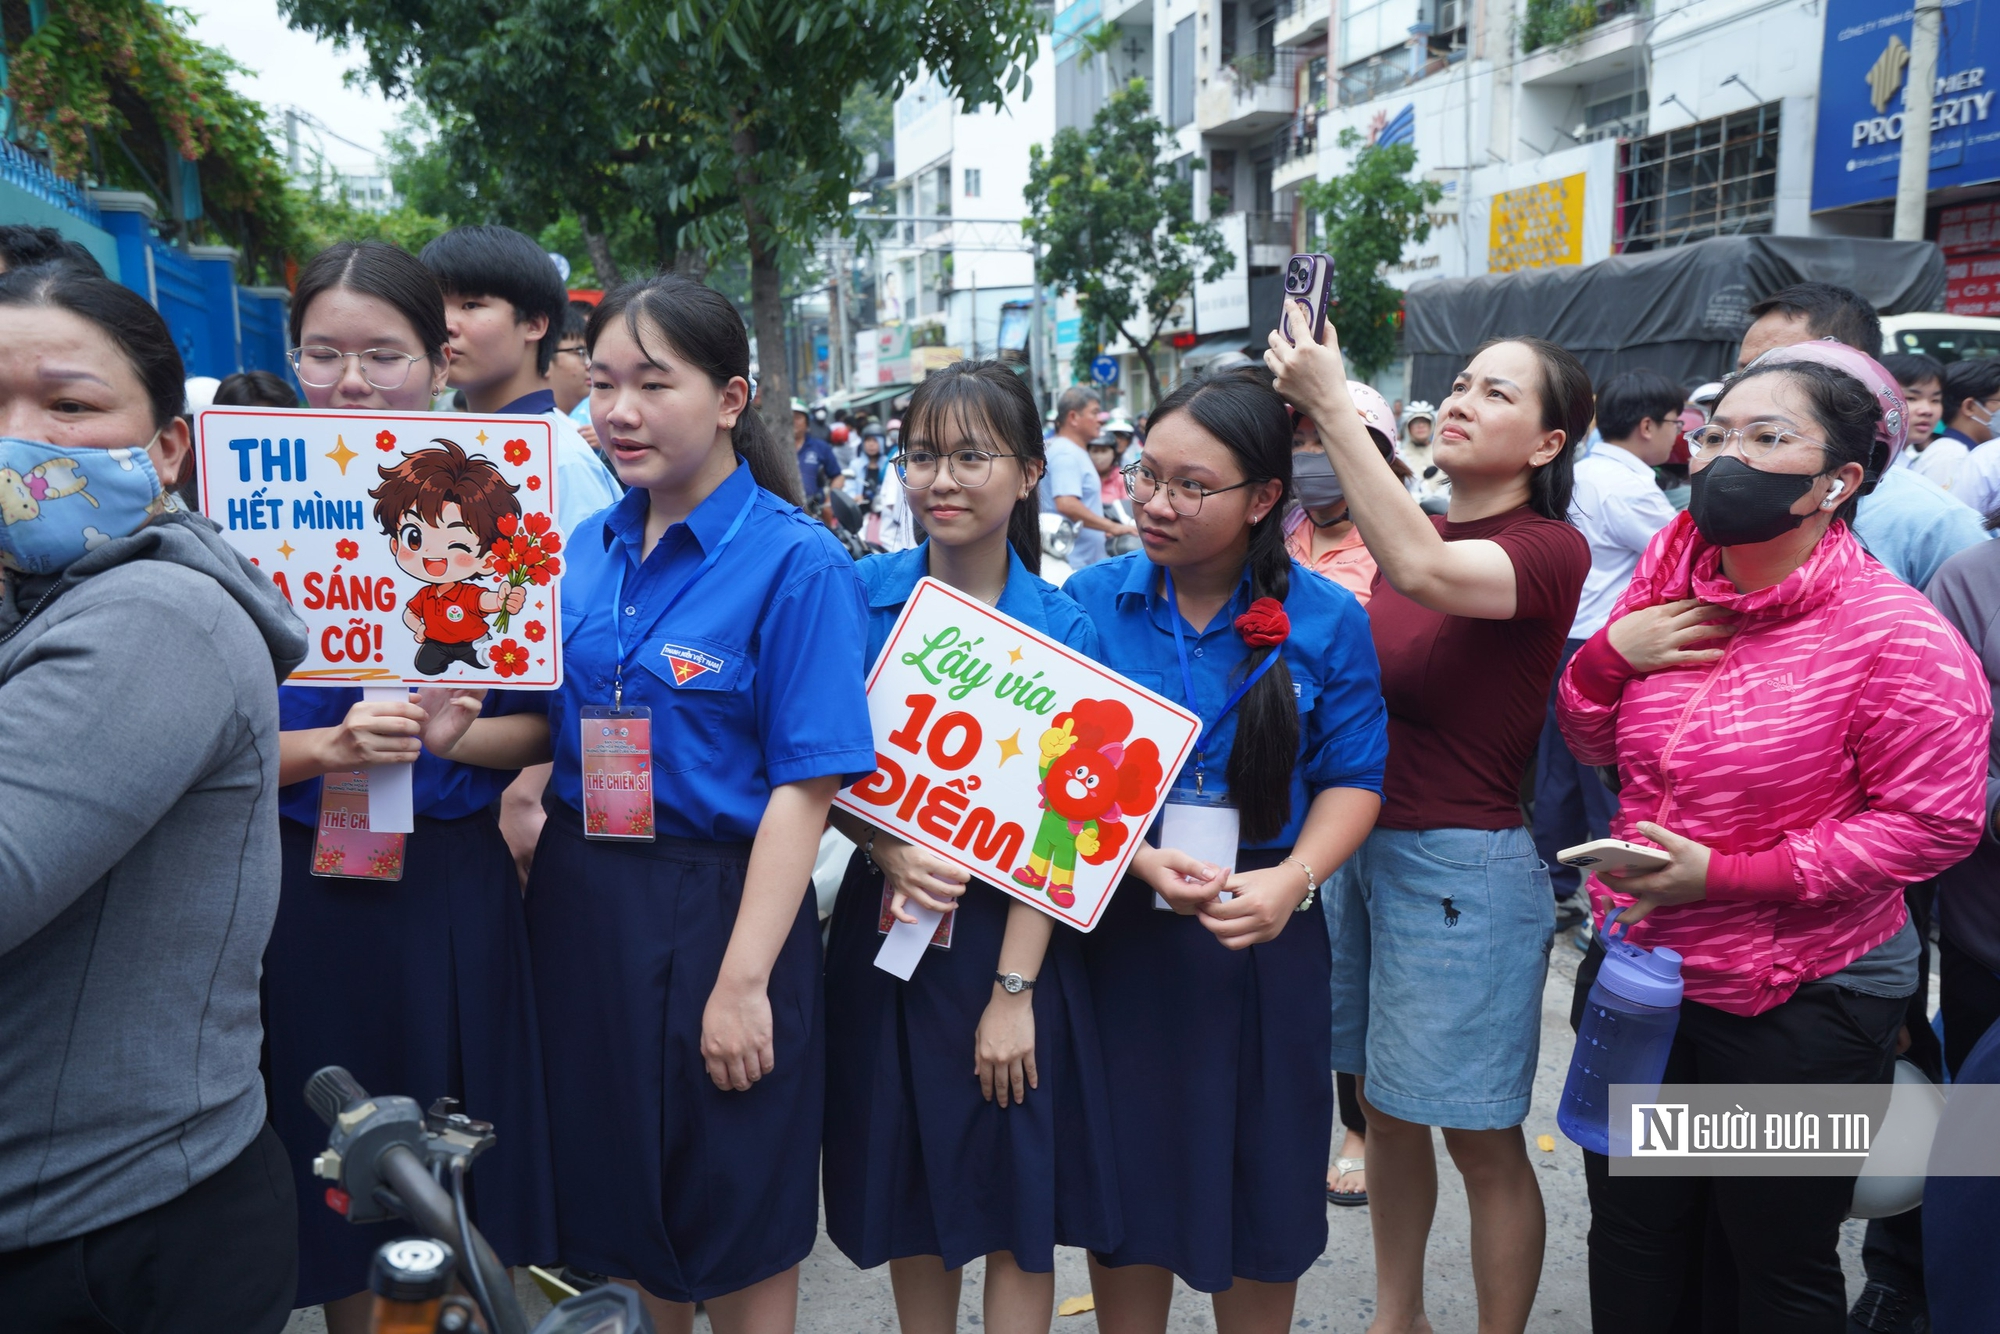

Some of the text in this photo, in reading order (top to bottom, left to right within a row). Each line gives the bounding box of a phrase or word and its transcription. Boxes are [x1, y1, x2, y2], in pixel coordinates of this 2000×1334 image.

[1852, 89, 1996, 149] PROERTY
[229, 438, 307, 483] THI
[228, 487, 364, 531] HẾT MÌNH
[303, 564, 396, 612] SÁNG
[321, 617, 383, 663] CỠ!
[901, 626, 1057, 715] Lấy vía
[888, 693, 983, 772] 10
[586, 769, 650, 791] THẺ CHIẾN SĨ
[323, 807, 347, 828] THẺ
[850, 751, 1025, 873] ĐIỂM
